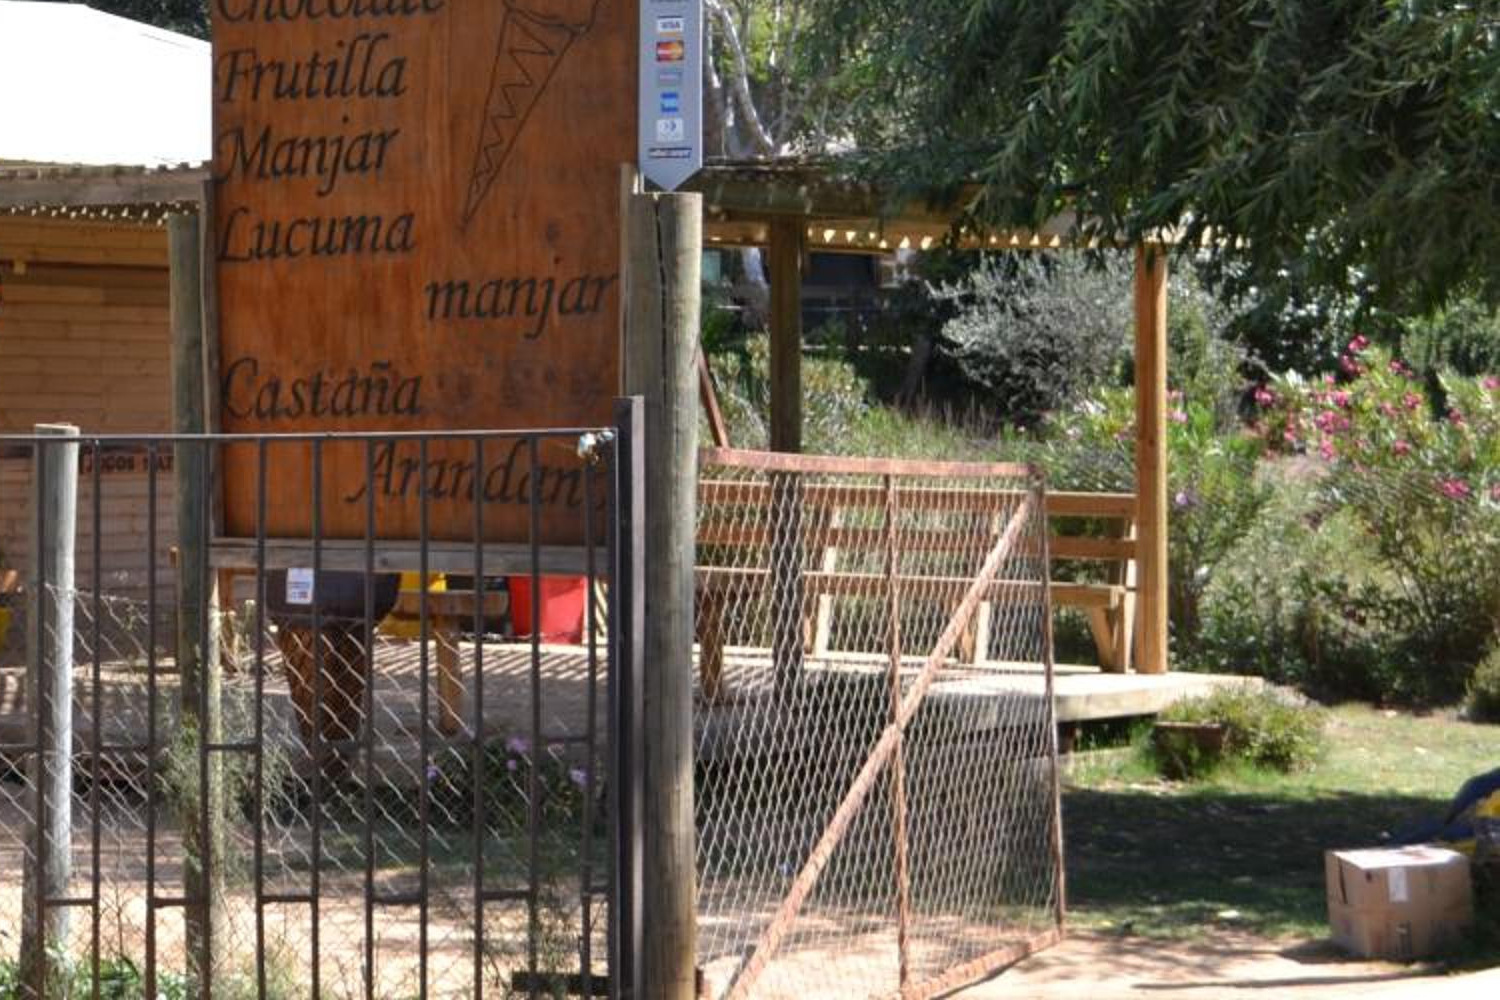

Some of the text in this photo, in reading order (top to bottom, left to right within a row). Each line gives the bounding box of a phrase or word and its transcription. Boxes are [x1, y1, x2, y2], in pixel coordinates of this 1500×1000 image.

[216, 33, 407, 101] Frutilla
[216, 115, 399, 196] Manjar
[219, 206, 416, 263] Lucuma
[426, 255, 618, 340] manjar
[222, 357, 422, 420] Castaña
